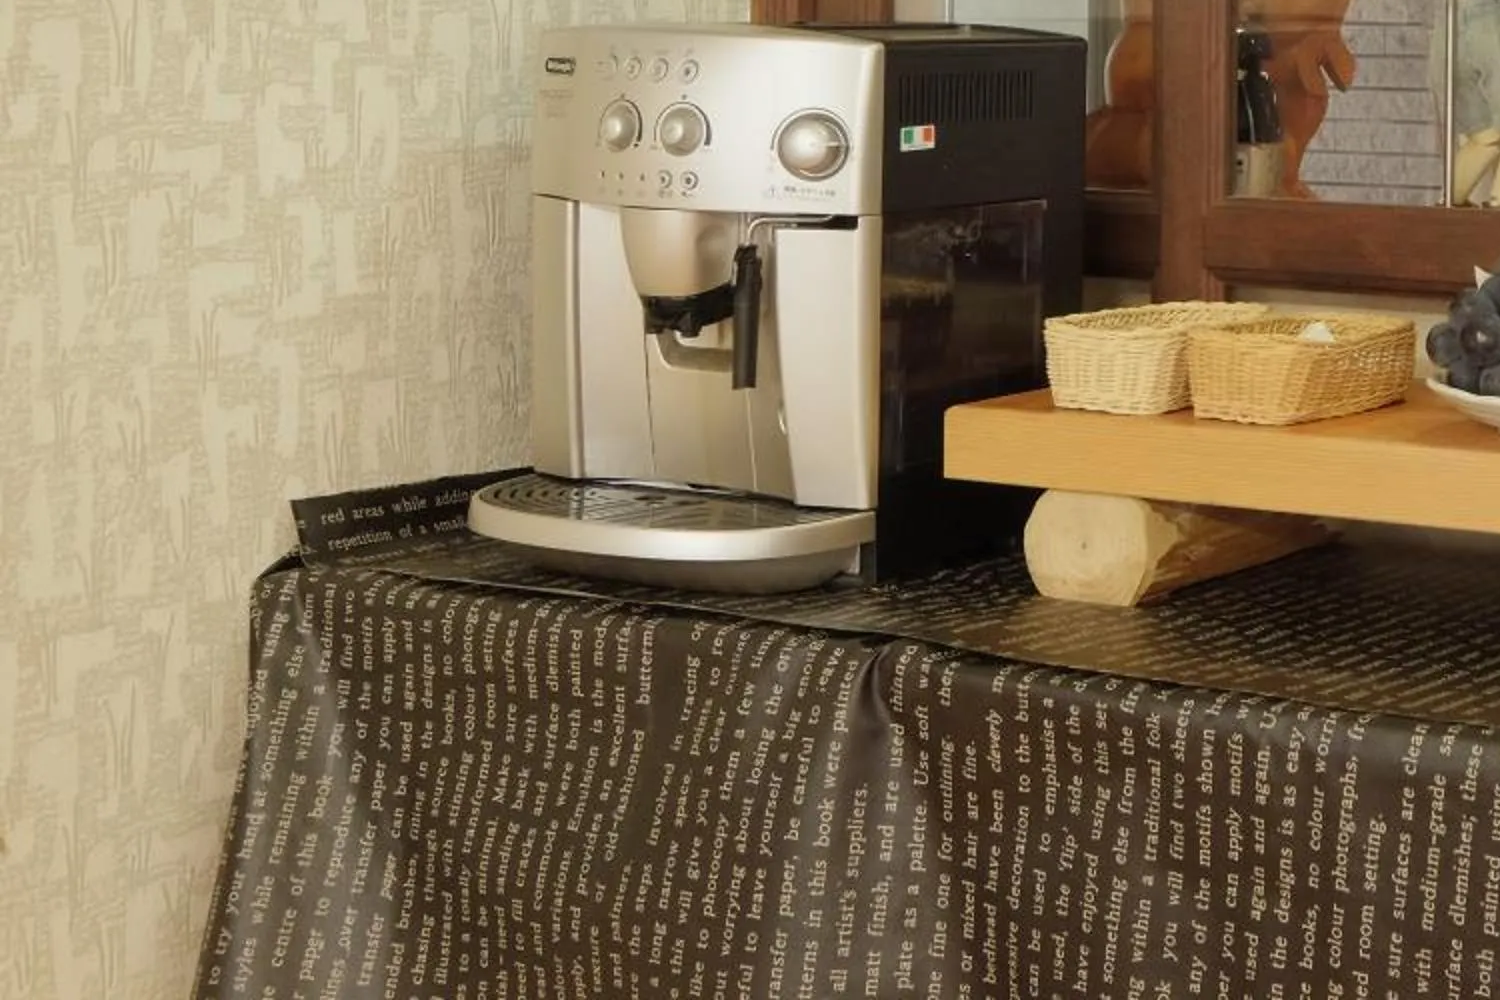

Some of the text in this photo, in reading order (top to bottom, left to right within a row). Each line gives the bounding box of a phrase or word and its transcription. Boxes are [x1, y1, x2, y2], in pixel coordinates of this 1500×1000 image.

[792, 736, 814, 806] careful
[813, 660, 859, 847] book were painted
[912, 750, 929, 786] Use
[913, 704, 929, 741] soft
[1458, 744, 1483, 802] these
[701, 750, 740, 918] photocopy them
[720, 726, 775, 957] worrying about losing
[745, 771, 782, 921] leave yourself
[983, 788, 1004, 893] have been
[1032, 718, 1060, 916] used emphasise
[1066, 774, 1083, 817] side
[1071, 698, 1111, 994] have enjoyed using set
[1130, 711, 1161, 963] within traditional folk
[1166, 699, 1194, 906] will sheets
[1224, 732, 1243, 862] apply motifs
[1272, 726, 1306, 924] designs easy
[1306, 785, 1324, 852] colour
[677, 835, 702, 925] will give
[864, 950, 881, 997] matt
[888, 722, 904, 768] used
[960, 830, 978, 940] mixed hair
[1005, 805, 1029, 911] decoration
[1102, 766, 1136, 985] something else from
[1188, 728, 1215, 995] any motifs shown
[1249, 865, 1267, 922] again
[1387, 724, 1429, 979] sure surfaces clean
[1418, 773, 1446, 932] medium-grade
[1479, 853, 1500, 938] painted
[835, 889, 856, 958] artist's
[893, 940, 914, 990] plate
[1326, 902, 1344, 970] colour
[1358, 904, 1375, 961] room
[1473, 948, 1494, 999] both
[828, 968, 848, 993] all
